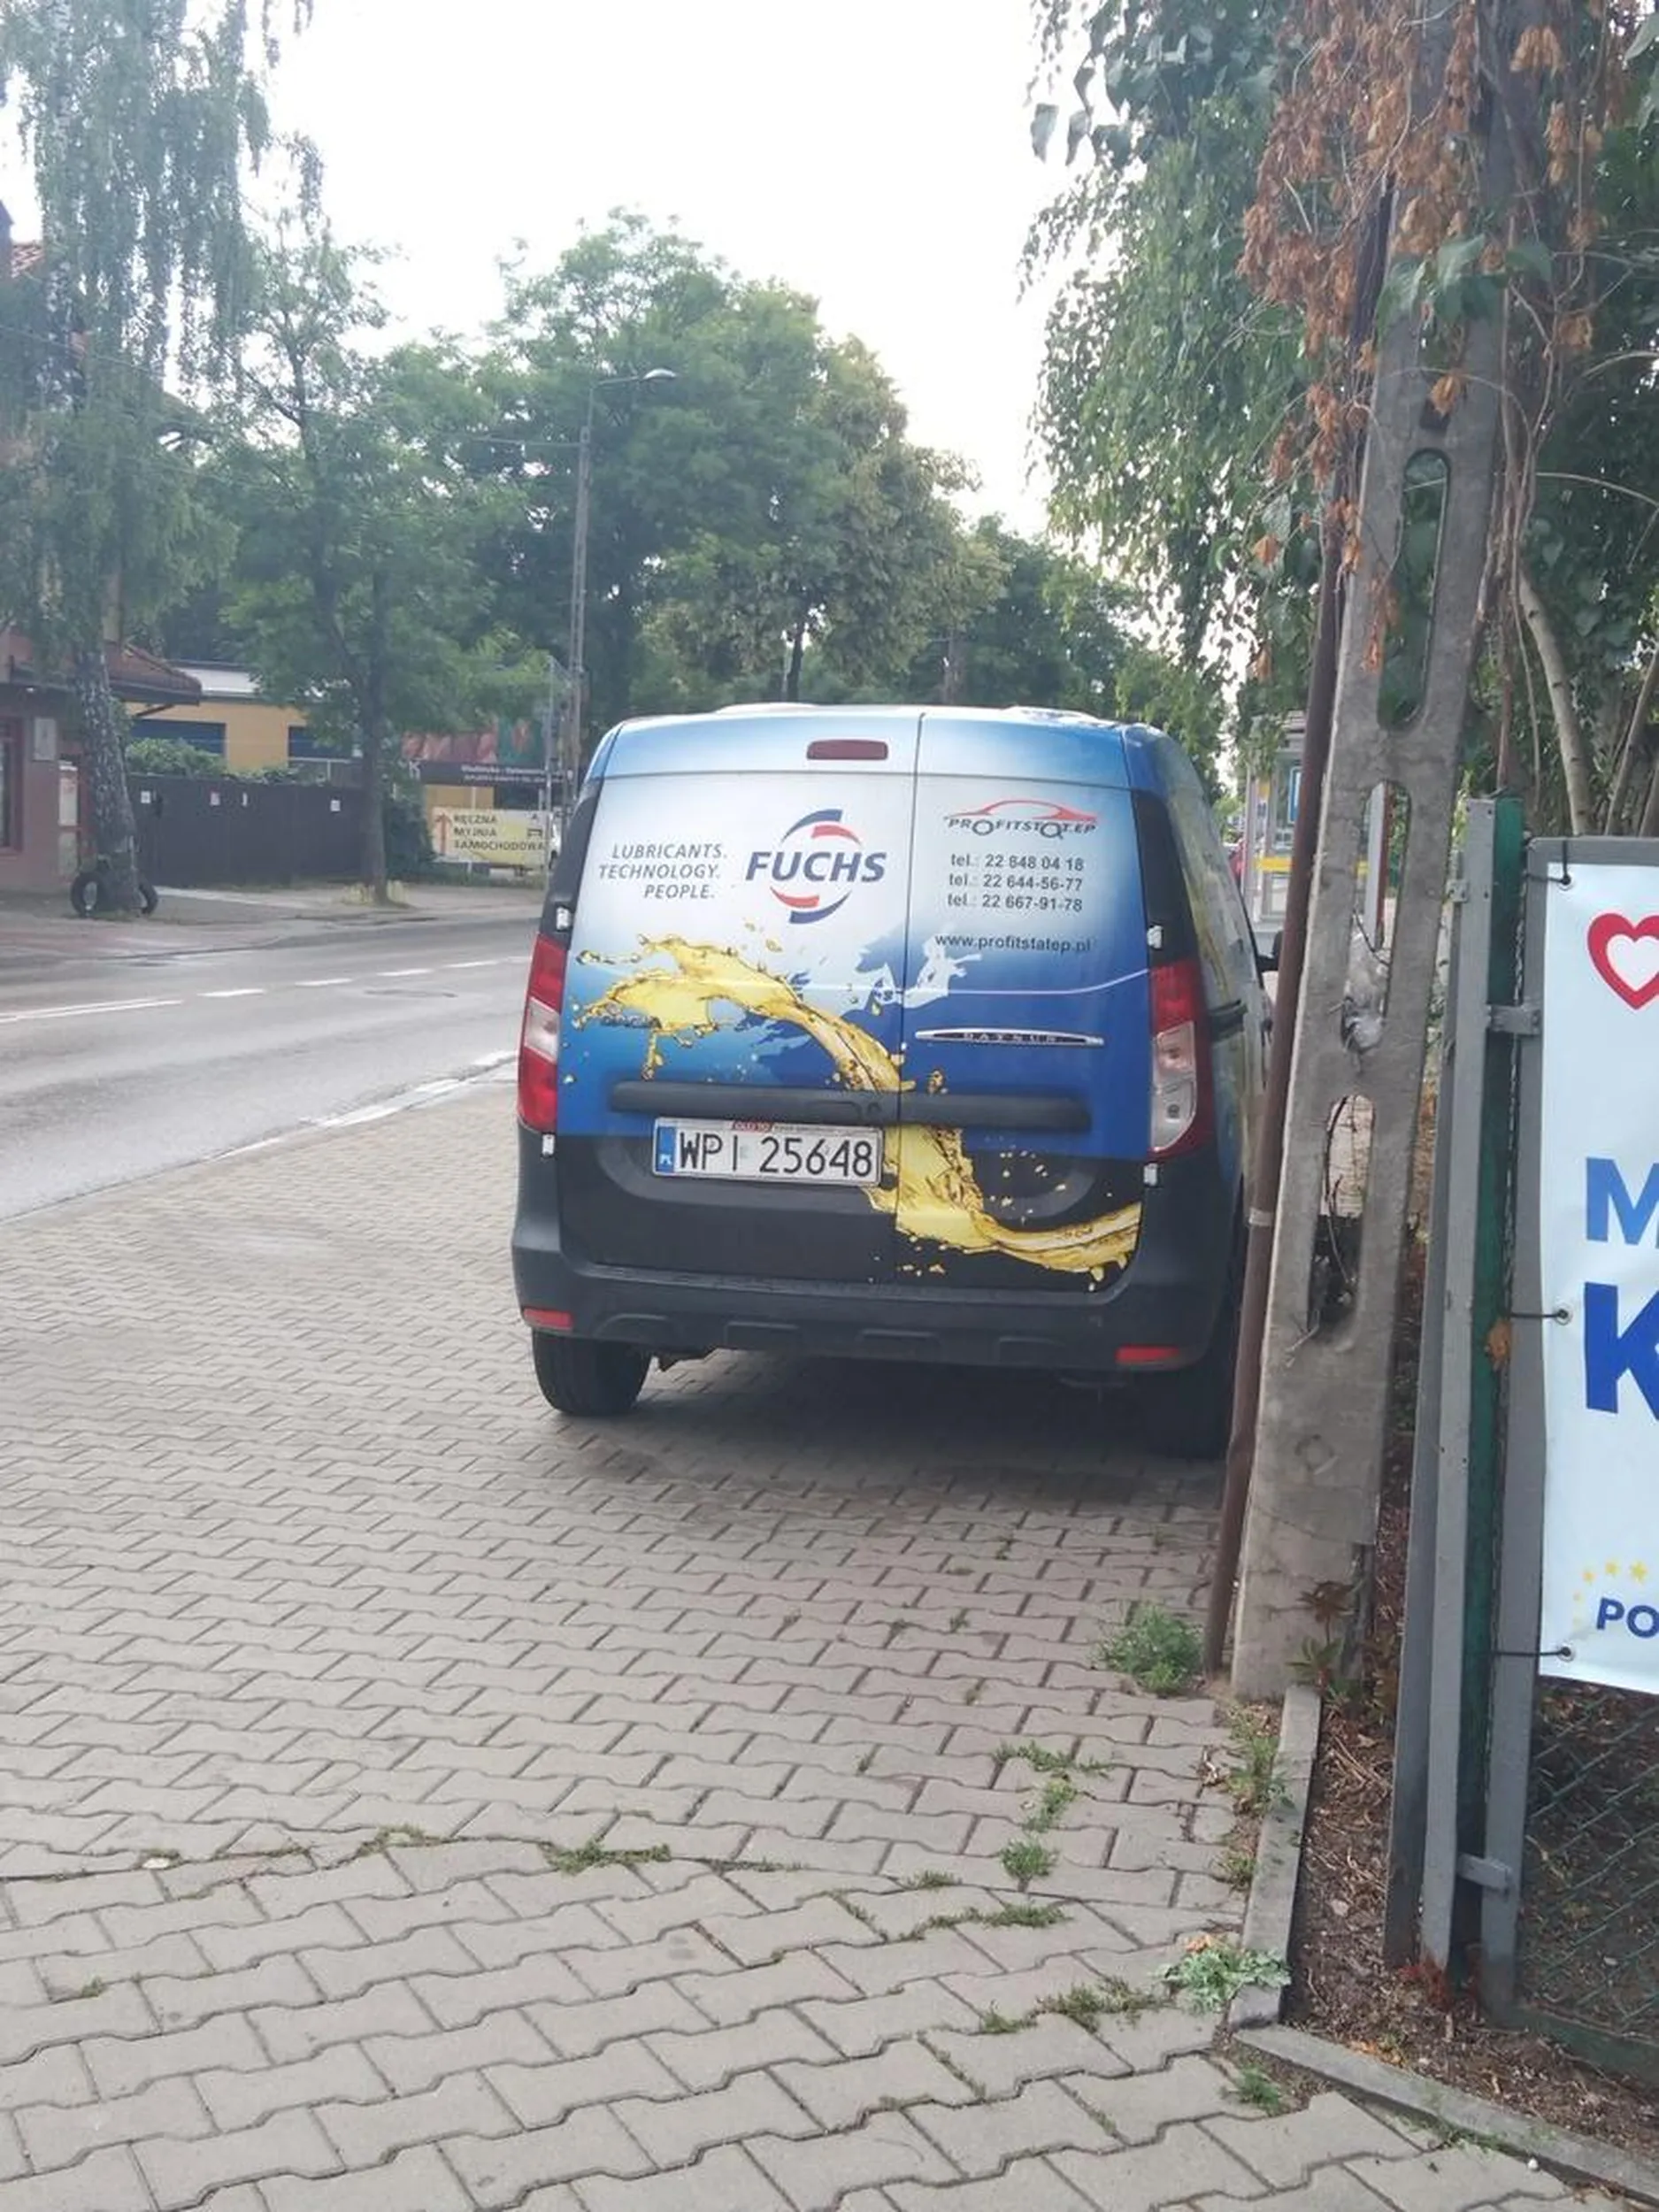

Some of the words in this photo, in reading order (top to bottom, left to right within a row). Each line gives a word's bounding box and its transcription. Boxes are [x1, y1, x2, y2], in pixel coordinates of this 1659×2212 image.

[612, 843, 727, 859] LUBRICANTS.
[599, 864, 720, 879] TECHNOLOGY.
[745, 851, 887, 883] FUCHS
[985, 854, 1004, 868] 22
[1041, 856, 1060, 870] 04
[1067, 857, 1084, 872] 18
[983, 874, 1002, 888] 22
[644, 885, 715, 899] PEOPLE.
[982, 894, 1001, 908] 22
[680, 1132, 738, 1171] WPI
[759, 1136, 873, 1179] 25648
[1584, 1281, 1659, 1420] K
[1596, 1597, 1659, 1639] PO
